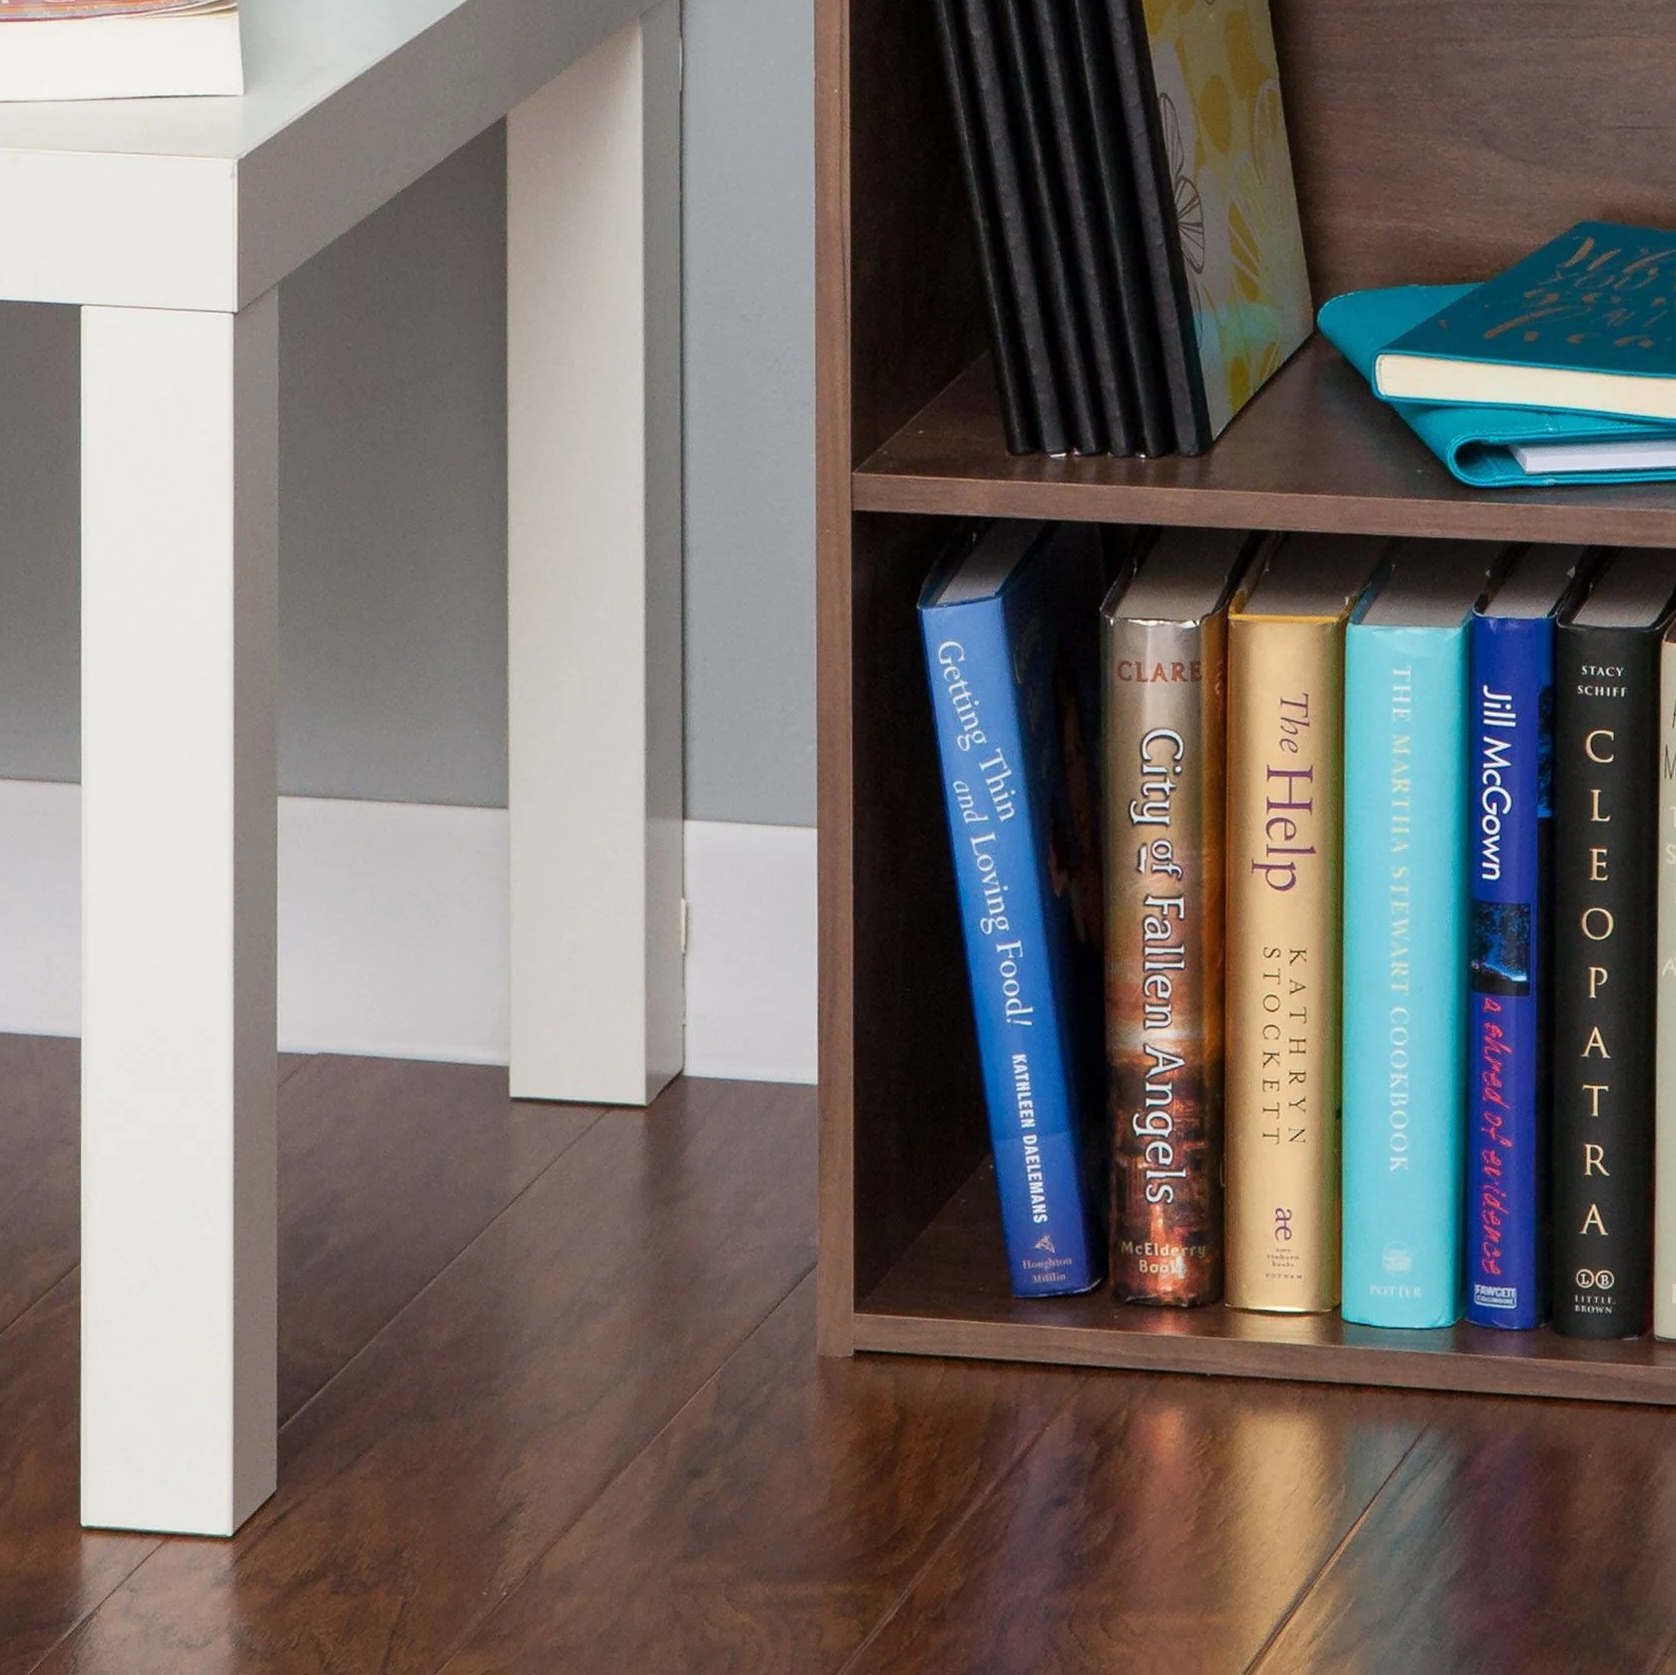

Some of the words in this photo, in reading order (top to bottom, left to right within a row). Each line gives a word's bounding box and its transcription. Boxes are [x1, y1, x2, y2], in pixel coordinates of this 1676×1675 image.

[1115, 660, 1202, 683] CLARE
[1392, 663, 1412, 723] THE
[1482, 685, 1517, 727] Jill
[1577, 685, 1628, 698] SCHIFF
[1581, 665, 1625, 677] STACY
[938, 640, 988, 752] Getting
[978, 747, 1016, 822] Thin
[1279, 691, 1310, 755] The
[952, 779, 990, 824] and
[1128, 726, 1185, 827] City
[1391, 733, 1410, 853] MARTHA
[1481, 736, 1512, 881] McGown
[1149, 837, 1184, 881] of
[1251, 764, 1317, 892] Help
[970, 831, 1011, 935] Loving
[1142, 894, 1186, 1031] Fallen
[1390, 863, 1411, 996] STEWART
[996, 939, 1034, 1027] Food!
[1578, 729, 1616, 1236] CLEOPATRA
[1261, 946, 1282, 1146] STOCKETT
[1287, 947, 1308, 1146] KATHRYN
[1389, 1007, 1410, 1172] COOKBOOK
[1011, 1053, 1036, 1129] KATHLEEN
[1132, 1043, 1187, 1205] Angels
[1022, 1134, 1049, 1224] DAELEMANS
[1481, 1148, 1510, 1276] evidence
[1021, 1256, 1073, 1272] Houghton
[1120, 1241, 1207, 1257] McElderry
[1139, 1259, 1186, 1275] Book
[1369, 1284, 1423, 1298] POTTER
[1575, 1304, 1613, 1314] BROWN
